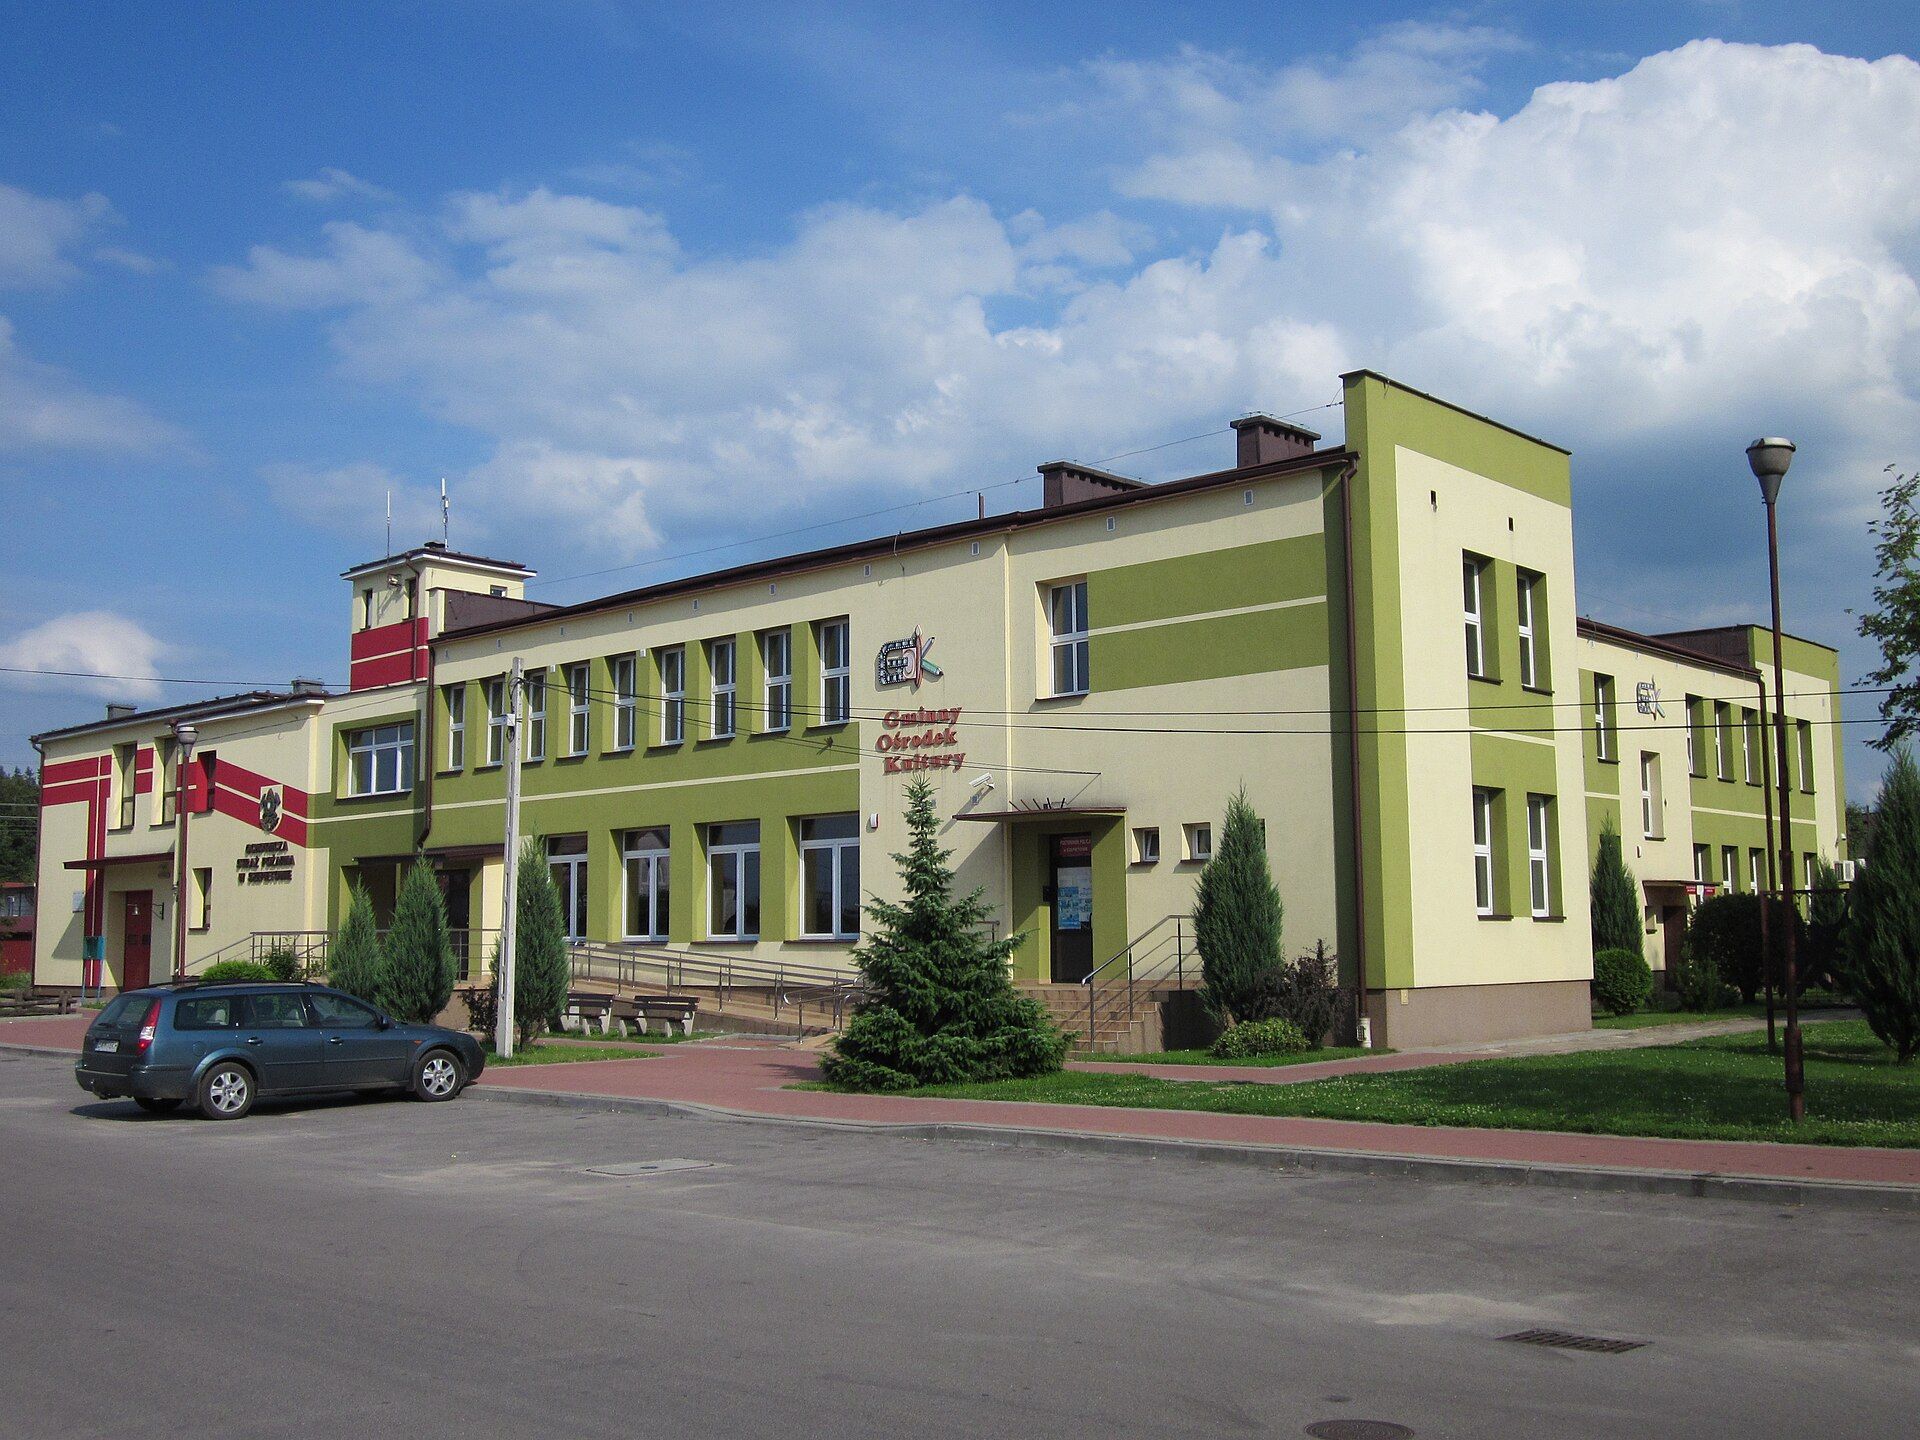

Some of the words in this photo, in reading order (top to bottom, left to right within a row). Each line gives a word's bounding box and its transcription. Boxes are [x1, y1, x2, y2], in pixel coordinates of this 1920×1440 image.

[883, 706, 962, 728] Gminny
[876, 728, 957, 752] Ośrodek
[884, 752, 965, 774] Kultury
